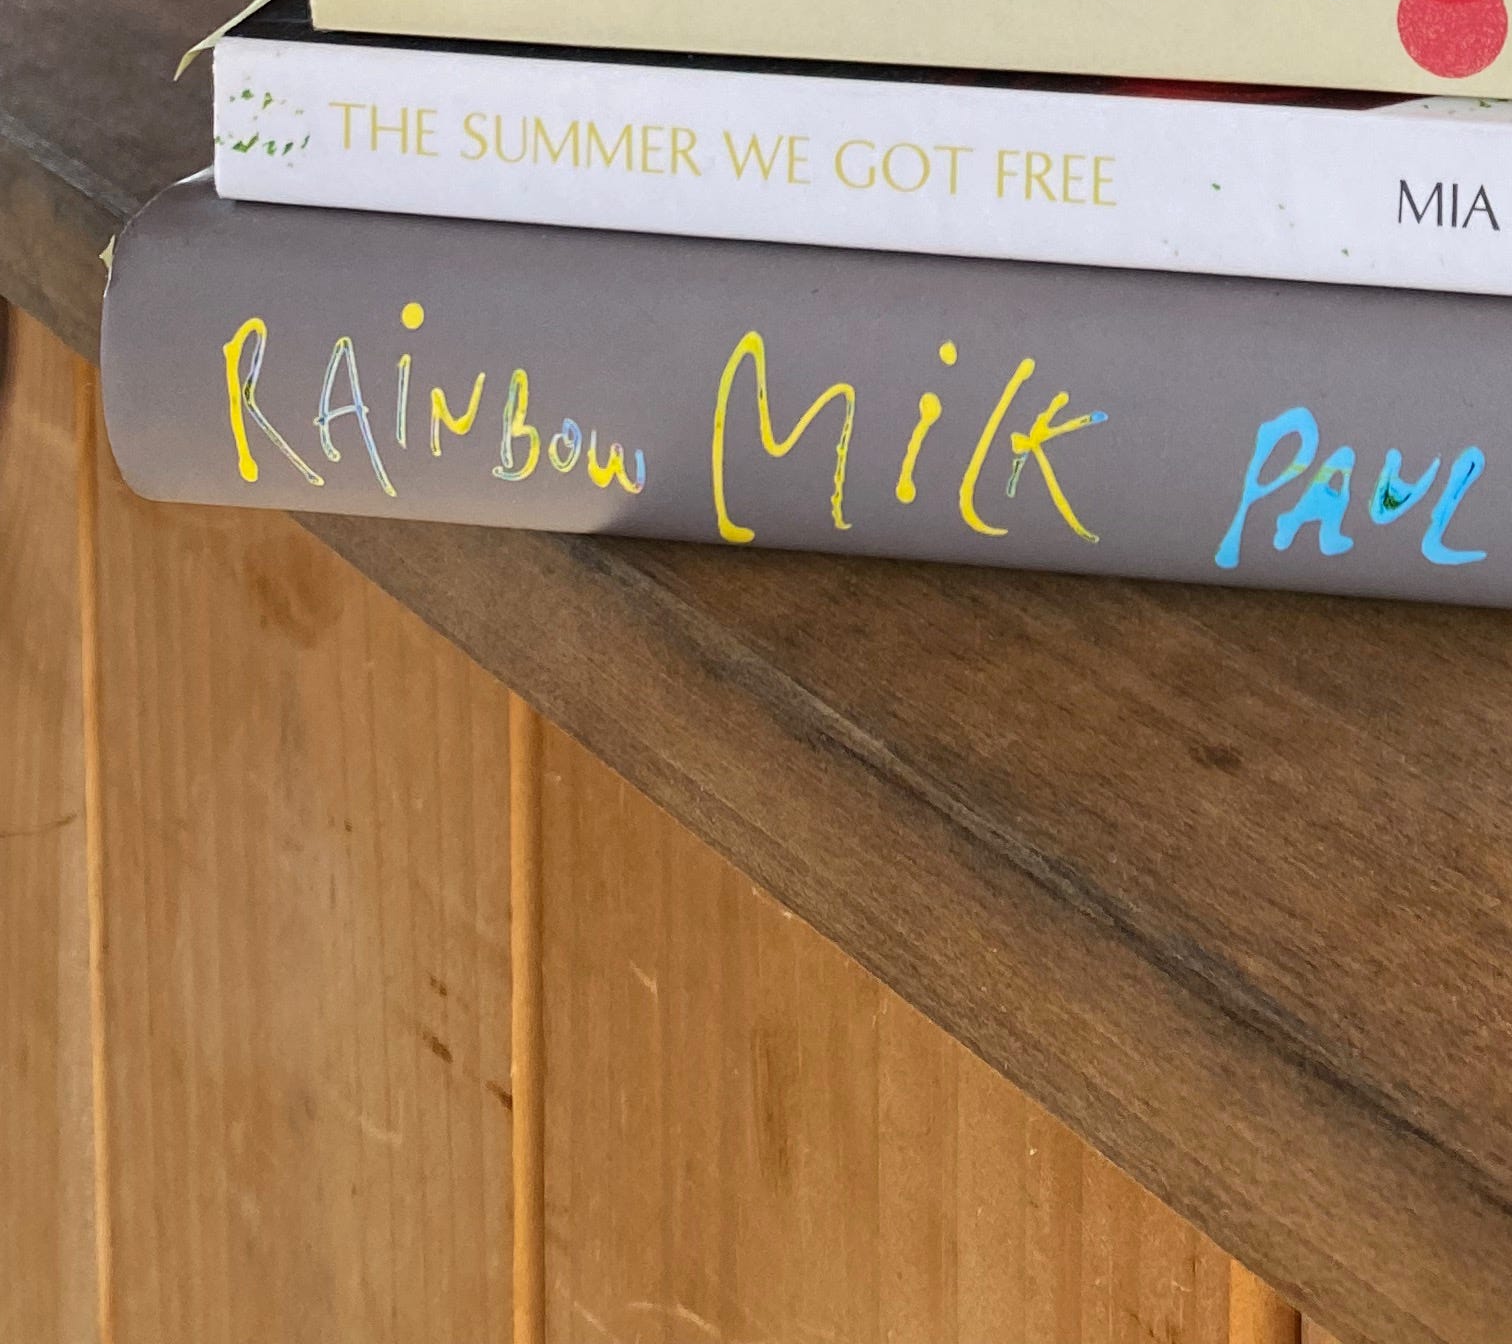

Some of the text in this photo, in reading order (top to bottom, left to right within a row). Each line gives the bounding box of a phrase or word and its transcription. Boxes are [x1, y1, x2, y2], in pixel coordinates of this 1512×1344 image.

[329, 99, 1119, 209] THE SUMMER WE GOT FREE
[1397, 178, 1501, 232] MIA
